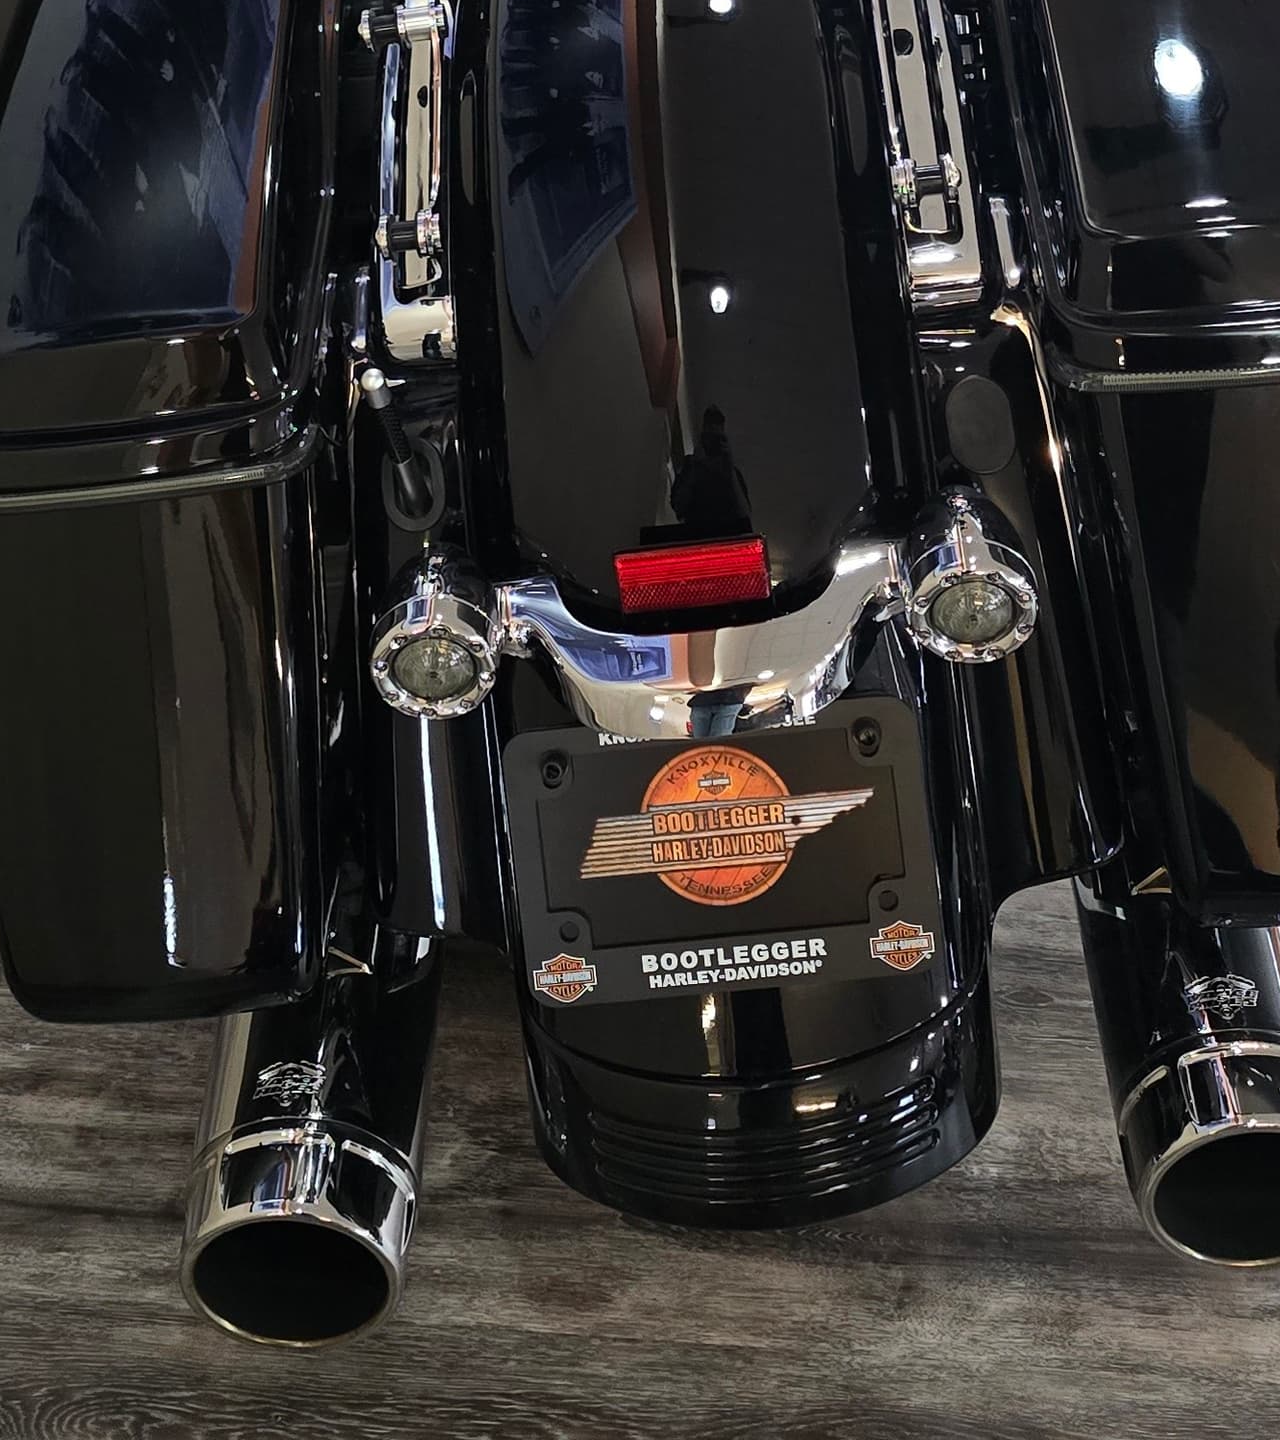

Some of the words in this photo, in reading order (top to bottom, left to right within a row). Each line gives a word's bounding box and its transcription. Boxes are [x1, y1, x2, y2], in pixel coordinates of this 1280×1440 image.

[667, 755, 759, 784] KNOXVILLE
[652, 803, 784, 834] BOOTLEGGER
[652, 832, 786, 863] HARLEY-DAVIDSON
[679, 866, 772, 896] TENNESSEE
[641, 938, 827, 973] BOOTLEGGER
